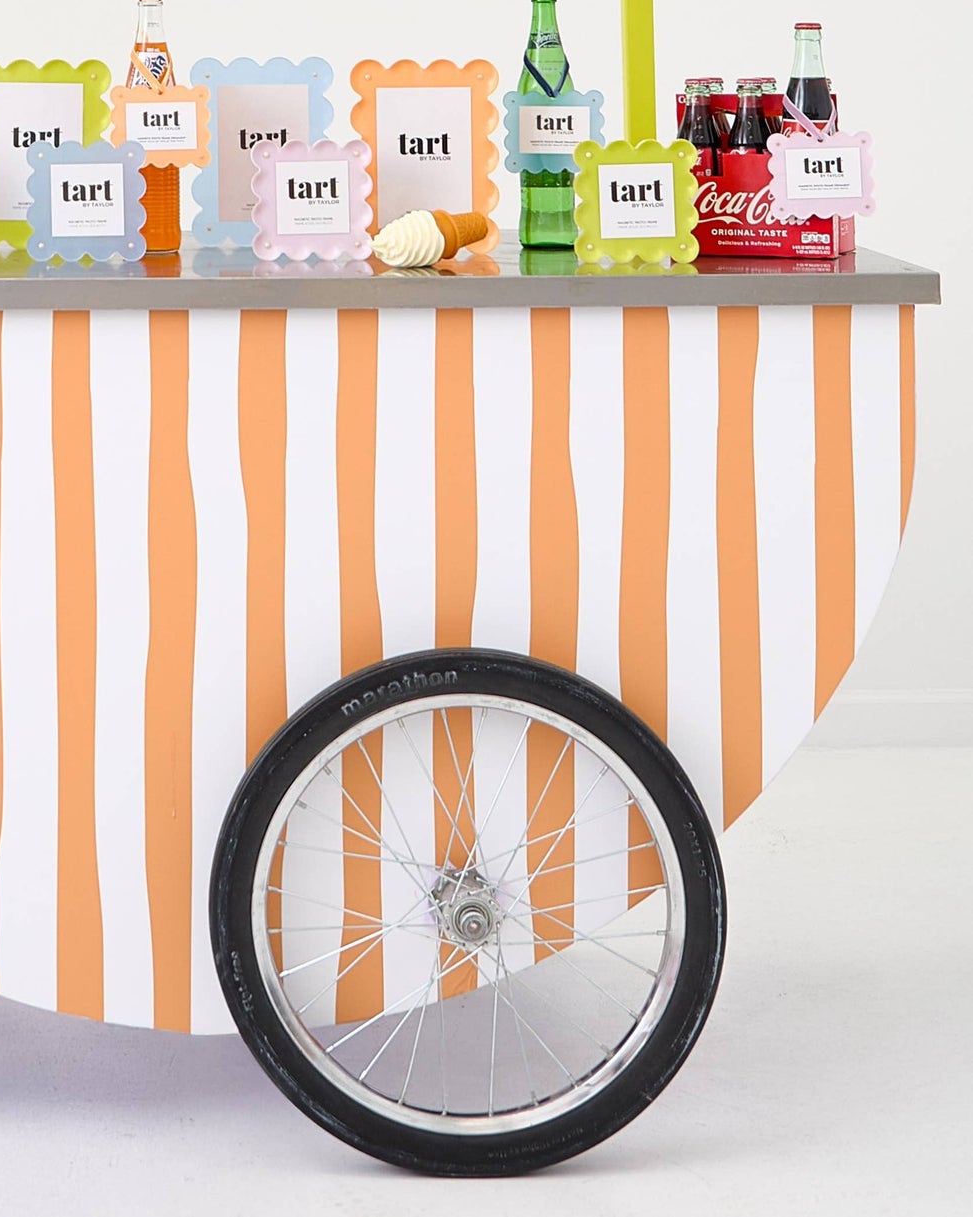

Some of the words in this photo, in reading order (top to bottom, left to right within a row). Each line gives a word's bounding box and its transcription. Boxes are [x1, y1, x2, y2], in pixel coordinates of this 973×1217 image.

[142, 111, 181, 127] tart
[535, 114, 574, 131] tart
[11, 127, 63, 148] tart
[238, 129, 290, 150] tart
[397, 133, 451, 155] tart
[803, 156, 844, 174] tart
[60, 180, 114, 202] tart
[286, 177, 339, 200] tart
[609, 179, 664, 203] tart
[711, 228, 756, 237] ORIGINAL
[758, 229, 788, 238] TASTE
[340, 670, 458, 717] marathon
